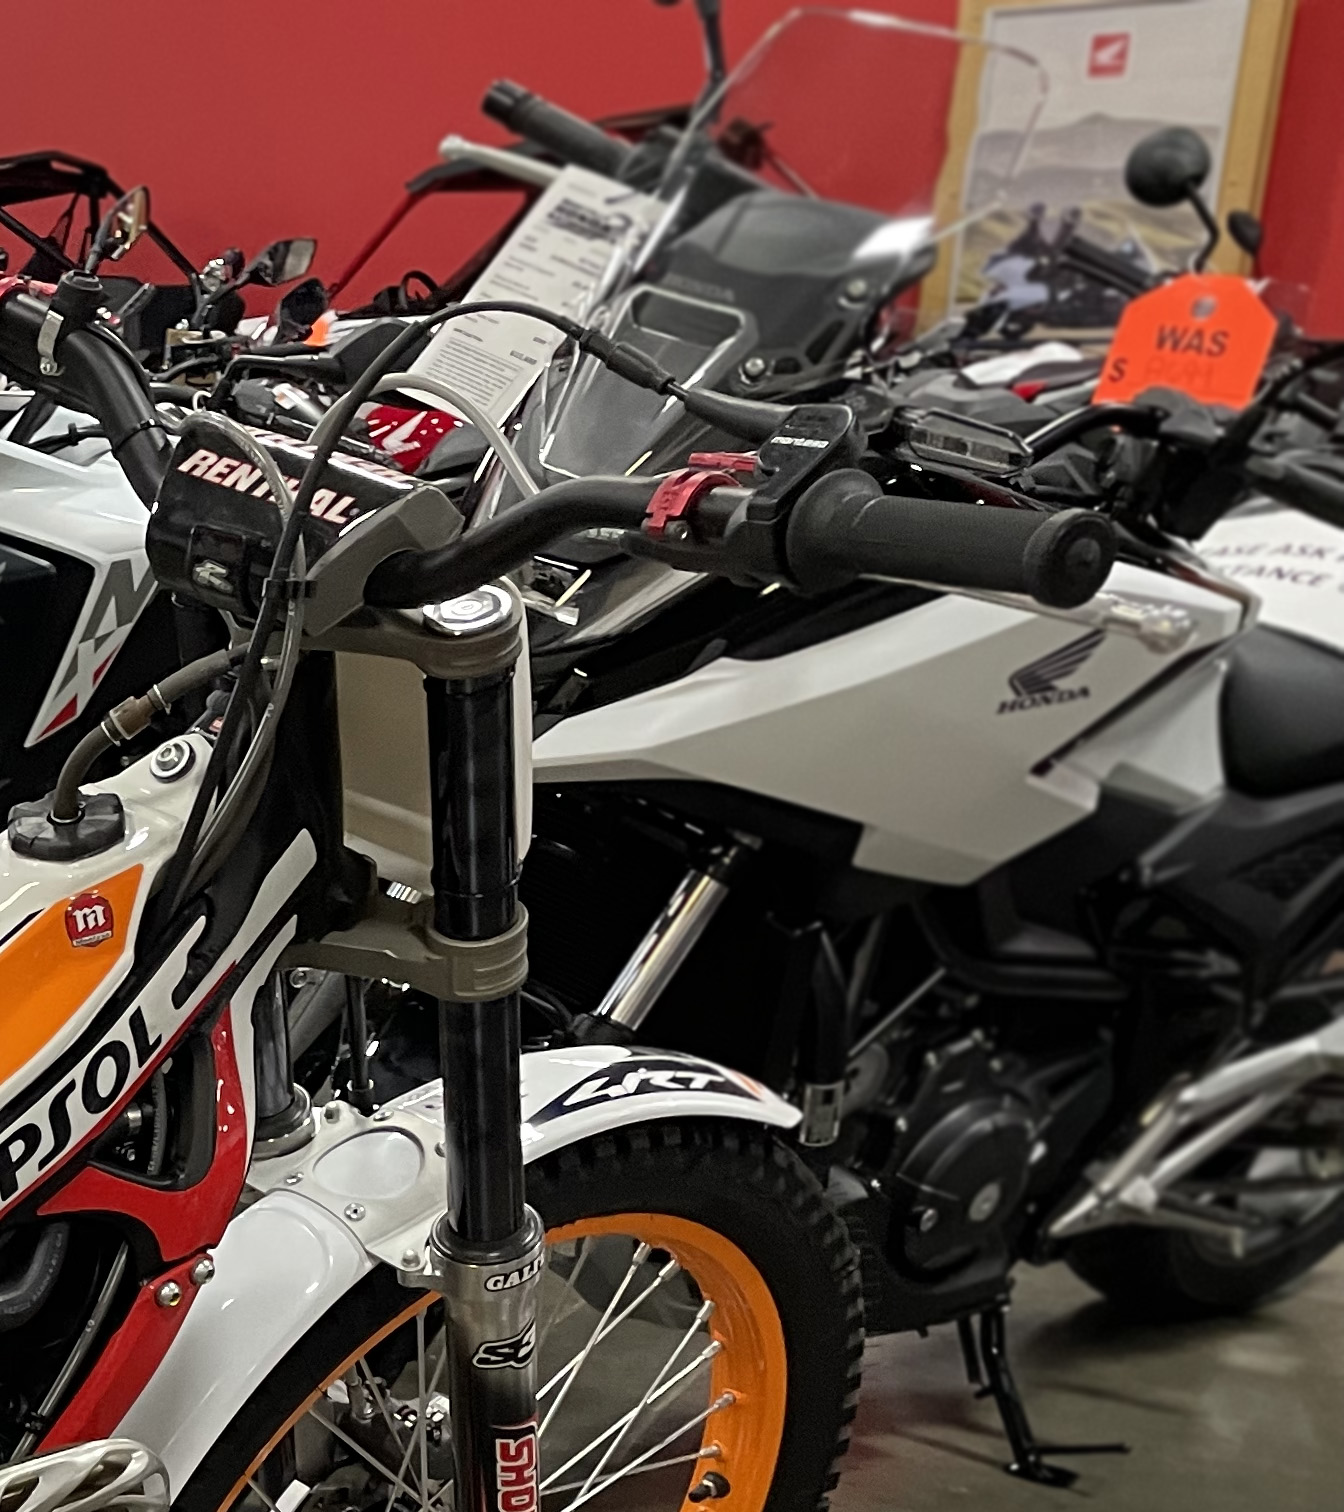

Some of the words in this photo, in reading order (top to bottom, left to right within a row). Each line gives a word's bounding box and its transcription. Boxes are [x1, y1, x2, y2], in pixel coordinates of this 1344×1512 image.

[1155, 322, 1230, 358] WAS
[177, 449, 356, 524] RENAL
[1220, 562, 1333, 588] TANCE
[996, 686, 1091, 715] HONDA
